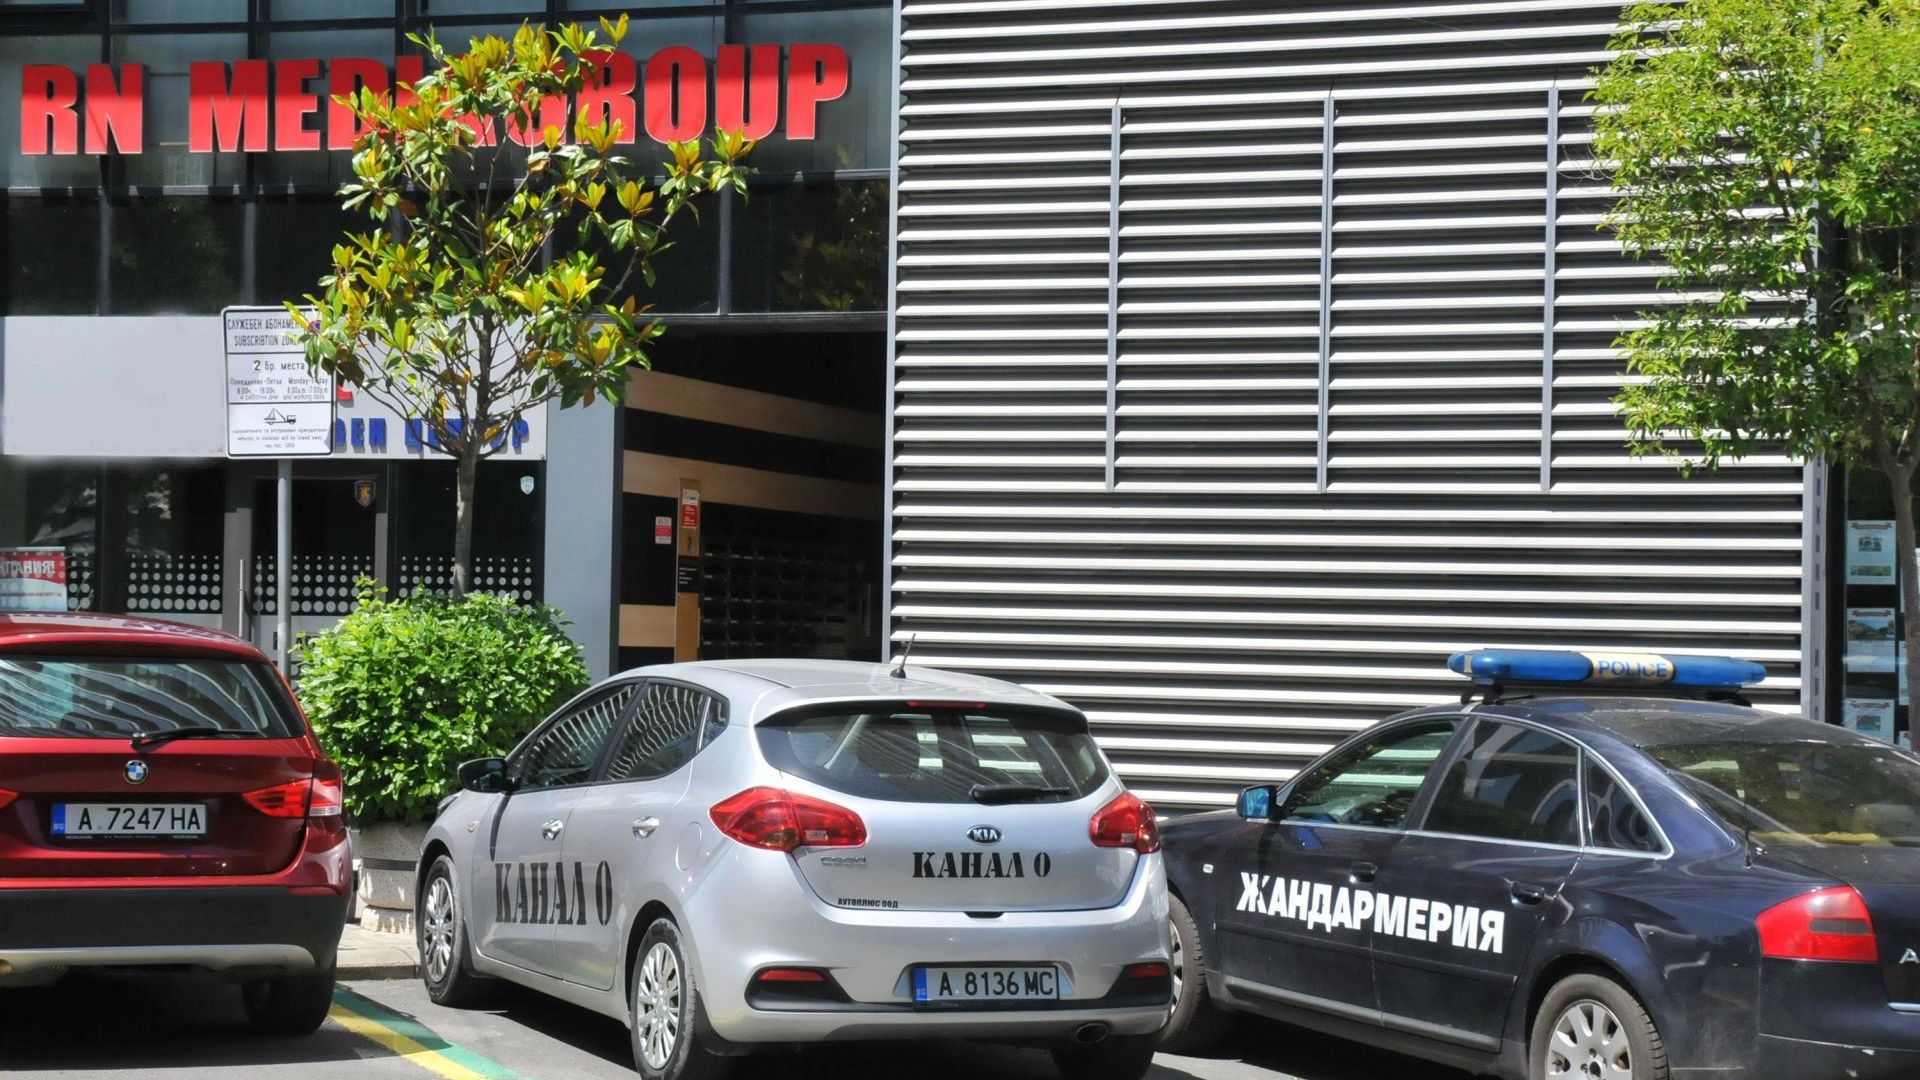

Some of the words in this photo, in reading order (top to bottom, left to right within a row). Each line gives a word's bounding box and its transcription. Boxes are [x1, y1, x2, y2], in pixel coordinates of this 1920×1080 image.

[21, 63, 144, 155] RN
[227, 319, 262, 330] СЛУЖЕБЕН
[234, 335, 279, 346] SUBSCRIBTION
[254, 359, 261, 371] 2
[281, 362, 305, 370] места
[1598, 660, 1668, 678] POLICE
[78, 807, 93, 830] A
[107, 807, 166, 830] 7247
[171, 807, 201, 830] HA
[973, 829, 998, 840] KIA
[912, 851, 1025, 879] КАНАЛ
[495, 861, 587, 926] КАНАЛ
[1236, 871, 1505, 954] ЖАНДАРМЕРИЯ
[938, 971, 953, 997] A
[964, 971, 1020, 996] 8136
[1024, 971, 1054, 996] MC
